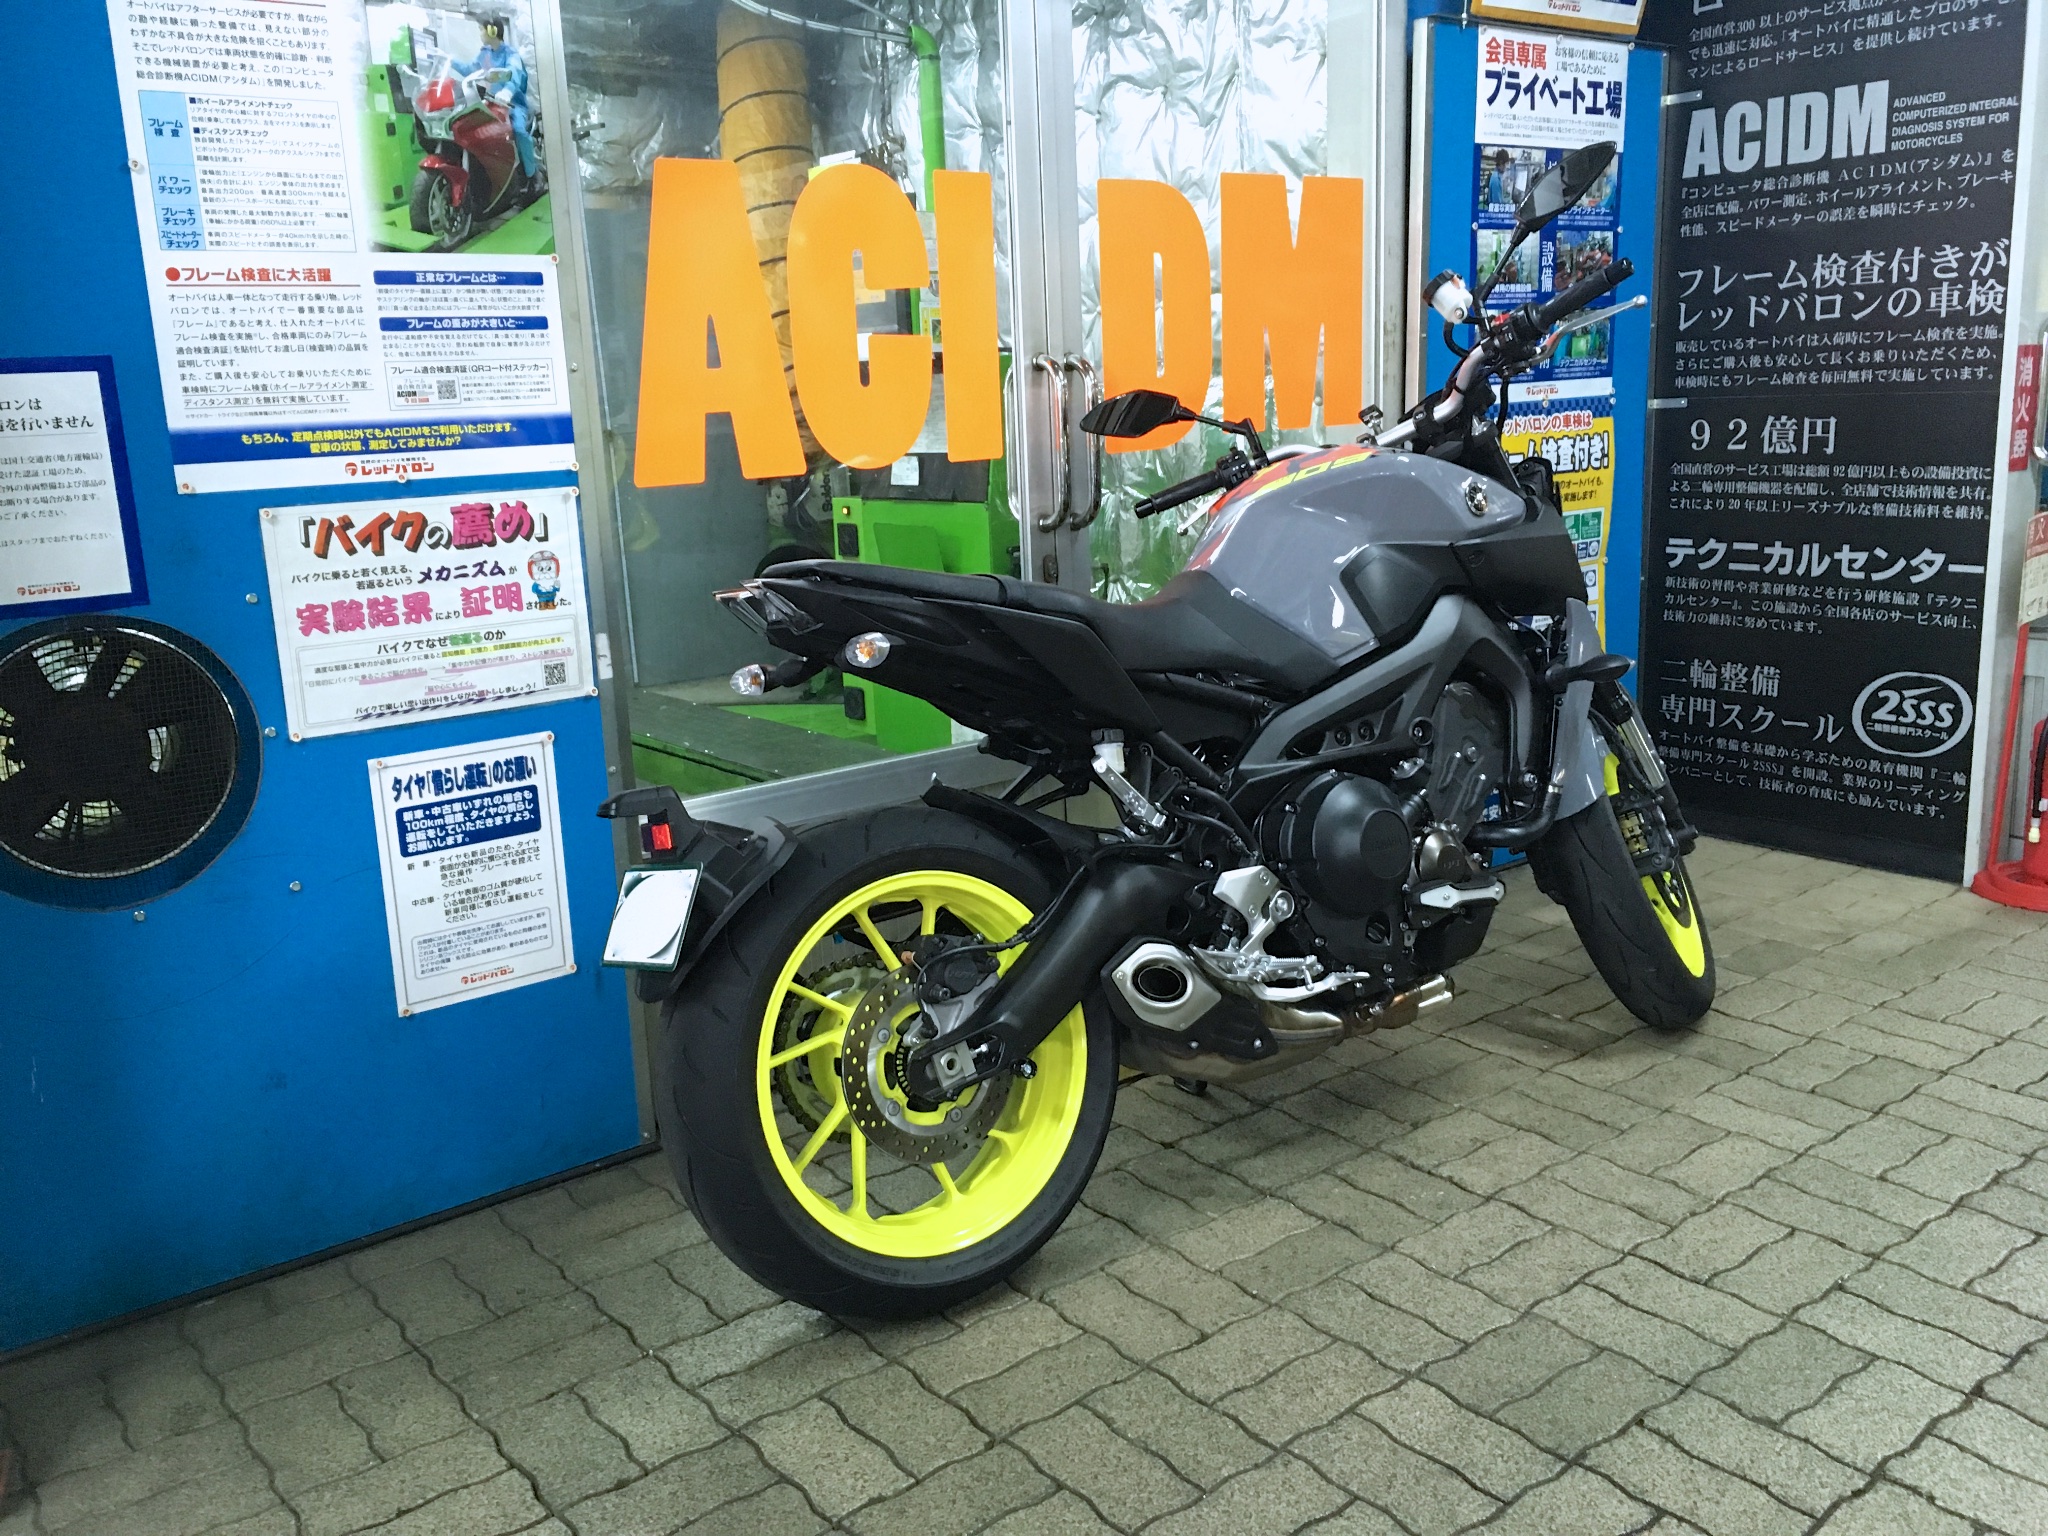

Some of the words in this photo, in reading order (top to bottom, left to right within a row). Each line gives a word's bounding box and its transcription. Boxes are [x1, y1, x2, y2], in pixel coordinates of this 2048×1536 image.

[1485, 37, 1547, 70] 会員専属
[1555, 47, 1619, 63] お客様の信頼に応える
[1556, 61, 1606, 75] 工場であるために
[1485, 67, 1622, 119] プライベート工場
[1893, 92, 1946, 109] ADVANCED
[1893, 103, 1967, 122] COMPUTERIZED
[1969, 96, 2019, 112] INTEGRAL
[147, 118, 183, 129] フレーム
[201, 127, 268, 137] ディスタンスチェック
[1682, 79, 1889, 179] ACIDM
[1892, 120, 1944, 136] DIAGNOSIS
[1946, 116, 1986, 130] SYSTEM
[1989, 112, 2009, 124] FOR
[1891, 133, 1963, 151] MOTORCYCLES
[157, 176, 190, 185] パワー
[158, 185, 192, 195] チェック
[1681, 169, 2015, 220] 全店に配備。パワー測定、ホイールアライメント、ブレーキ
[161, 207, 195, 217] ブレーキ
[163, 217, 196, 226] チェック
[1680, 194, 1977, 238] 性能、スピードメーターの誤差を瞬時にチェック。
[160, 230, 202, 240] スピードメーター
[166, 239, 199, 248] チェック
[181, 267, 332, 282] フレーム検査に大活躍
[1542, 242, 1554, 292] 設備
[1677, 239, 2007, 298] フレーム検査付きが
[170, 306, 364, 315] バロンでは、オートバイで一番重要な部品は
[1677, 278, 2006, 332] レッドバロンの車検
[1675, 324, 2004, 354] 販売しているオートバイは入荷時にフレーム検査を実施。
[178, 359, 240, 368] 証明しています。
[1675, 345, 1998, 371] さらにご購入後も安心して長くお乗りいただくため、
[1675, 365, 1995, 390] 車検時にもフレーム検査を毎回無料で実施しています。
[2011, 356, 2033, 459] 消火器
[241, 422, 518, 445] もちろん、定期点検時以外でもACIDMをご利用いただけます。
[360, 462, 435, 476] レッドバロン
[1670, 462, 1992, 481] 全国直営のサービス工場は総額92億円以上もの設備投資に
[1669, 480, 1993, 501] よる二輪専用整備機器を配備し、全店舗で技術情報を共有。
[1669, 496, 1991, 521] これにより20年以上リーズナブルな整備技術料を維持。
[298, 500, 549, 559] 「バイクの薦め」
[508, 566, 518, 576] が
[1665, 537, 1985, 584] テクニカルセンター
[291, 565, 413, 584] バイクに乗ると若く見える、
[356, 576, 413, 591] 若返るという
[417, 561, 505, 584] メカニズム
[461, 582, 525, 619] 証明
[296, 592, 435, 637] 実験結果
[435, 610, 460, 621] により
[1663, 609, 1825, 636] 技術力の維持に努めています。
[1660, 657, 1781, 699] 二輪整備
[1658, 693, 1844, 745] 専門スクール
[1870, 689, 1956, 729] 2SSS
[1659, 729, 1966, 786] オートバイ整備を基礎から学ぶための教育機関『二輪
[403, 789, 533, 822] 新車・中古車いずれの場合も
[407, 835, 470, 853] お願いします。
[441, 877, 473, 888] ください。
[446, 913, 477, 924] ください。
